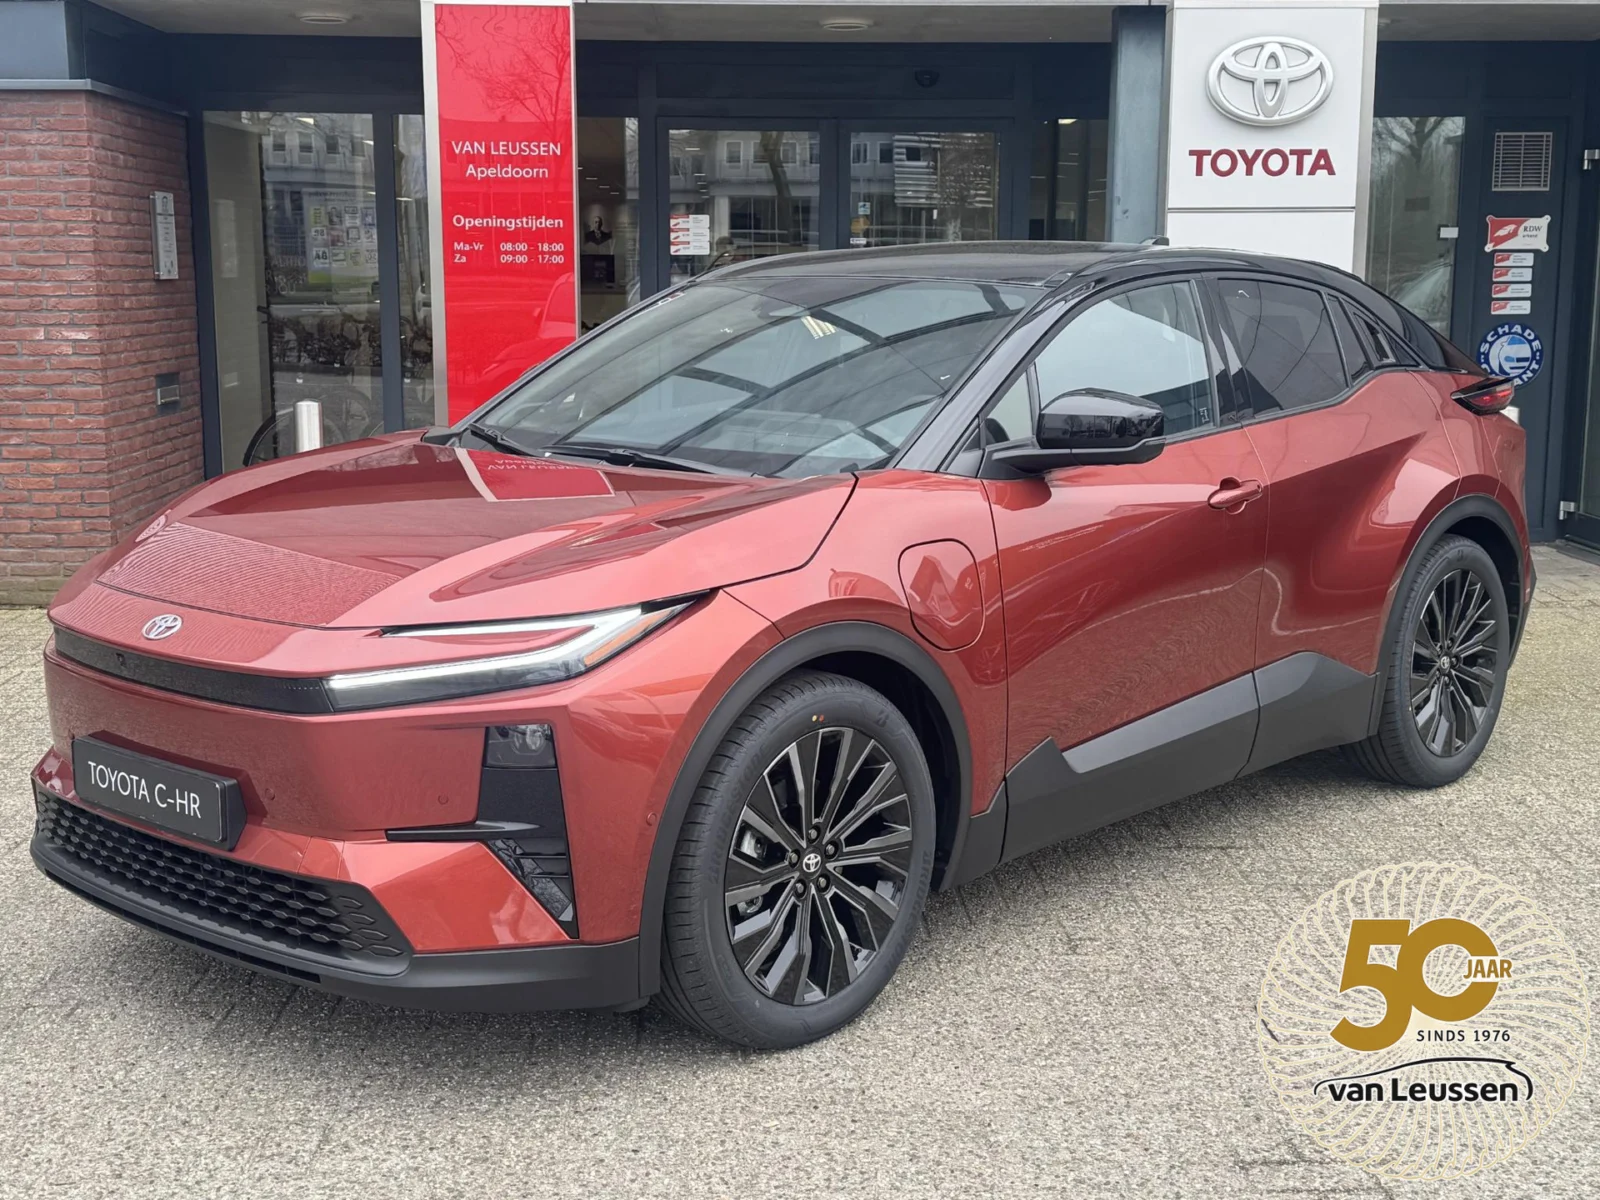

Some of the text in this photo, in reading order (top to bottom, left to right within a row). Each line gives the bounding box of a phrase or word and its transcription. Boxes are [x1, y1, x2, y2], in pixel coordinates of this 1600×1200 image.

[452, 141, 561, 156] VAN LEUSSEN
[1188, 148, 1337, 178] TOYOTA
[465, 164, 548, 180] Apeldoorn
[452, 214, 563, 231] Openingstijden
[1523, 225, 1543, 233] RDW
[453, 242, 484, 251] Ma-Vr
[500, 242, 528, 252] 08:00
[537, 243, 564, 252] 18:00
[453, 253, 467, 263] Za
[500, 254, 528, 264] 09:00
[537, 254, 564, 264] 17:00
[1480, 324, 1542, 354] SCHADE
[87, 760, 202, 819] TOYOTA C-HR
